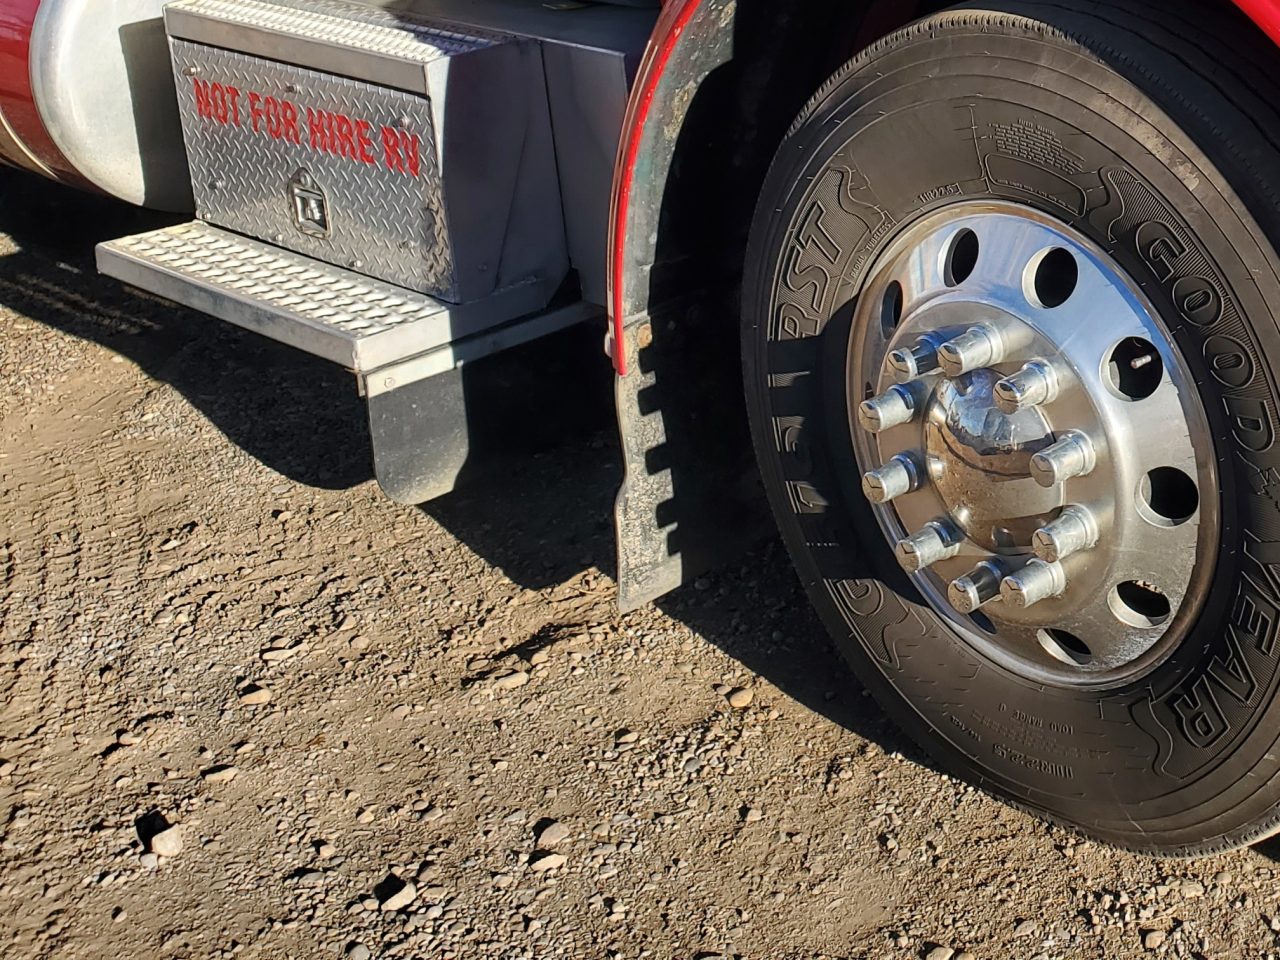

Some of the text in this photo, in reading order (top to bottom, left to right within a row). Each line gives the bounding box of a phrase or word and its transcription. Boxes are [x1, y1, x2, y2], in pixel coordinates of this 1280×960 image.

[193, 77, 420, 177] NOT FOR HIRE RV
